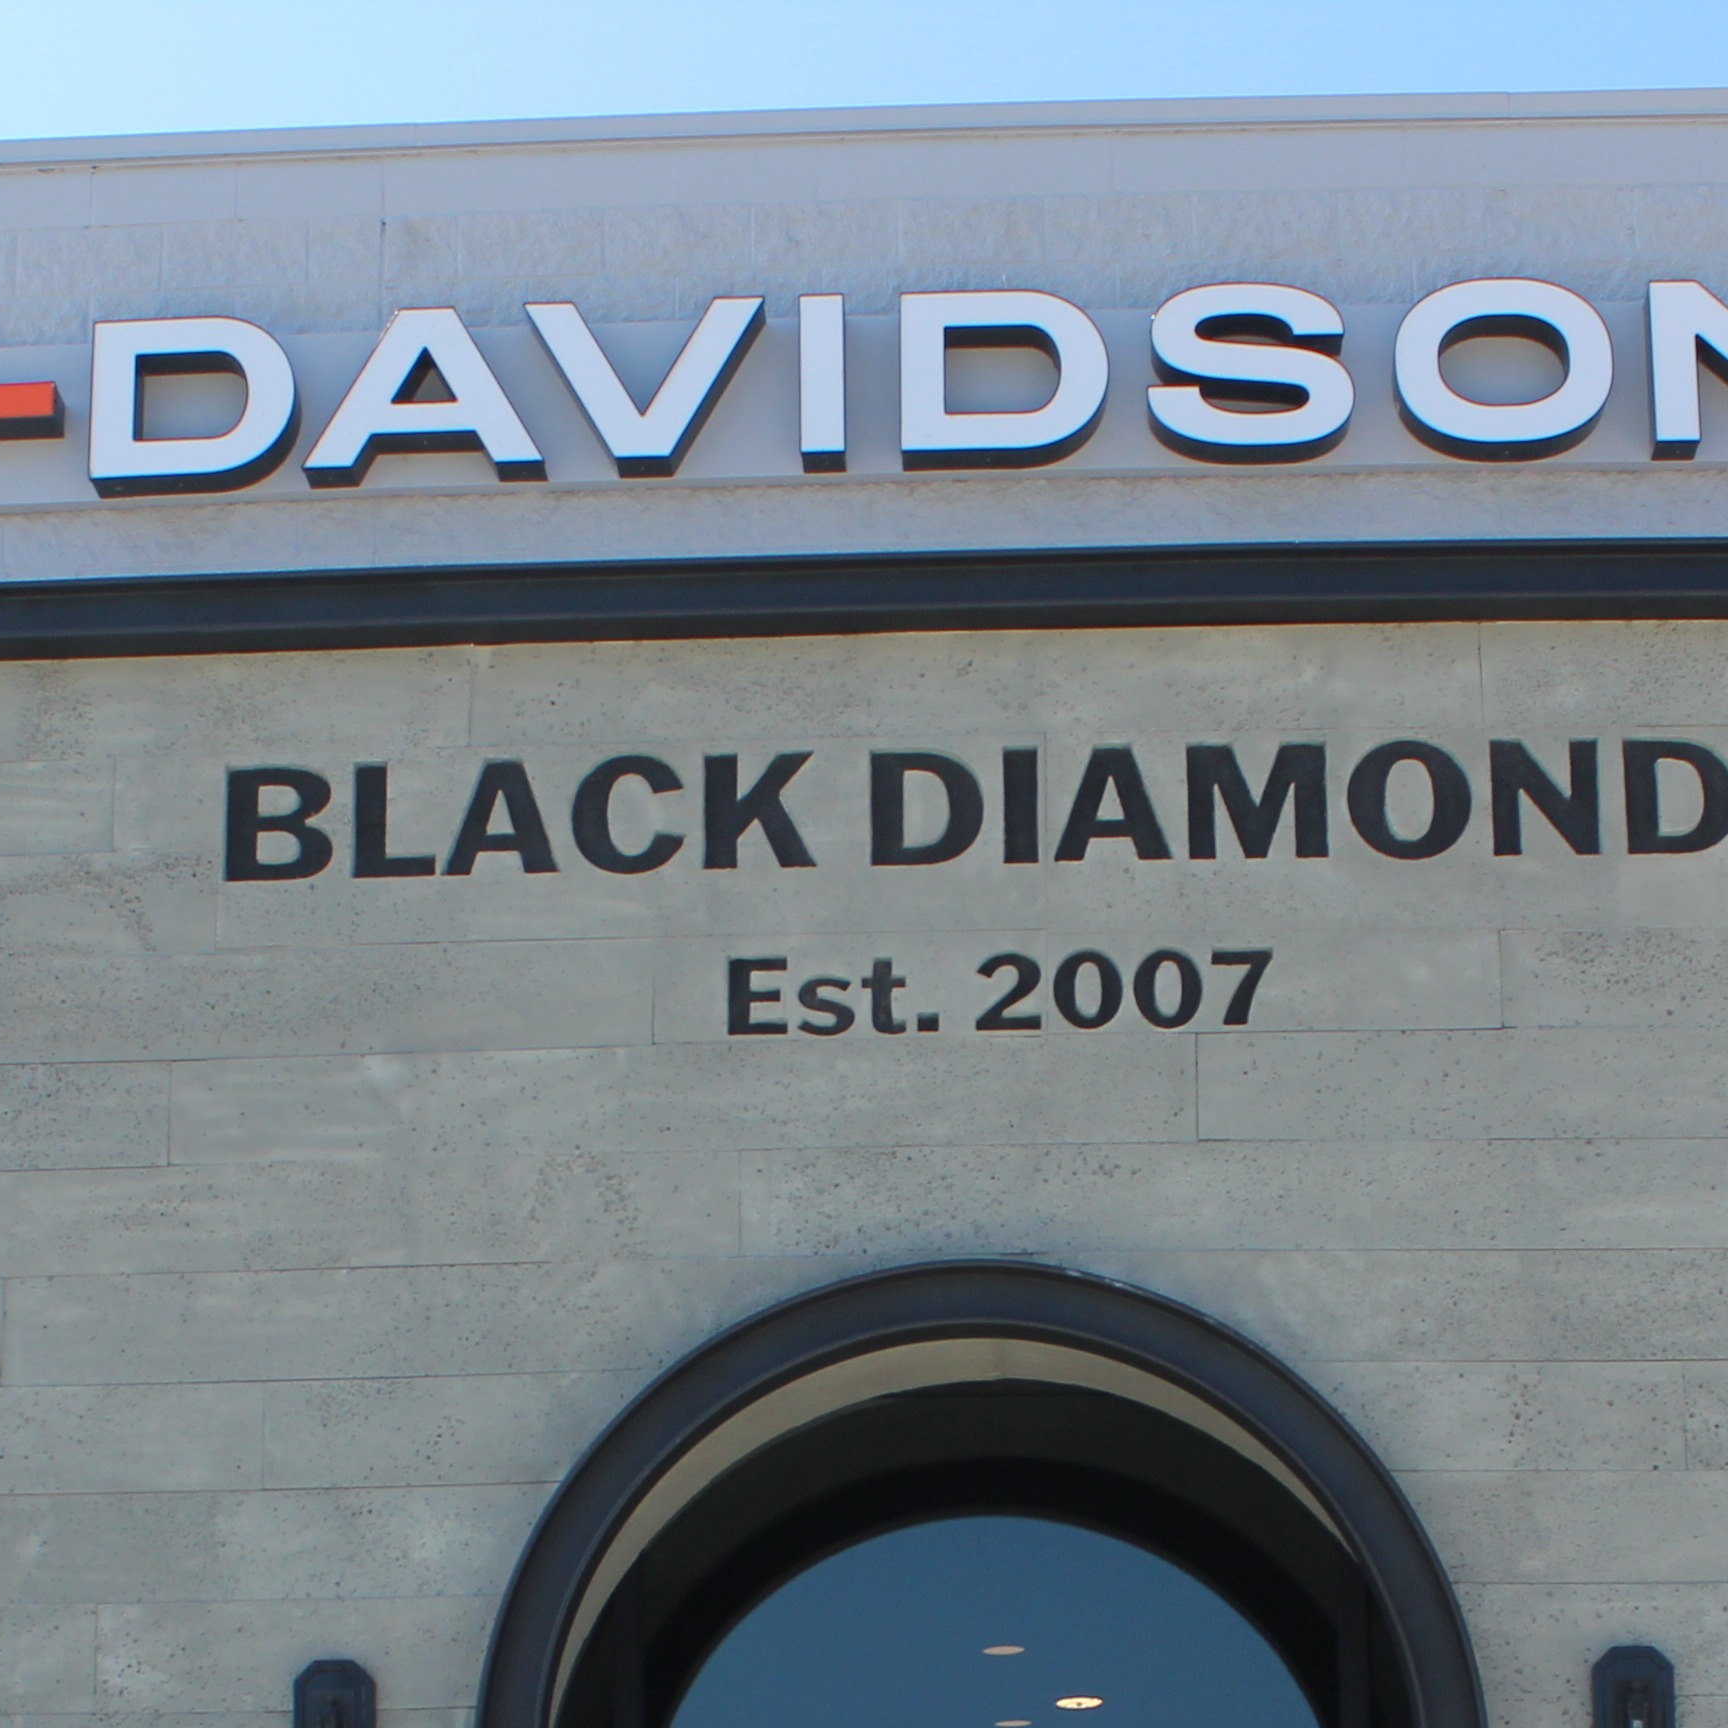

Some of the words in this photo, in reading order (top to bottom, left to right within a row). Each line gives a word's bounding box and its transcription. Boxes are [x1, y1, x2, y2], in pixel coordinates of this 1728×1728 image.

[222, 750, 816, 882] BLACK
[726, 956, 940, 1037] Est.
[974, 948, 1274, 1031] 2007
